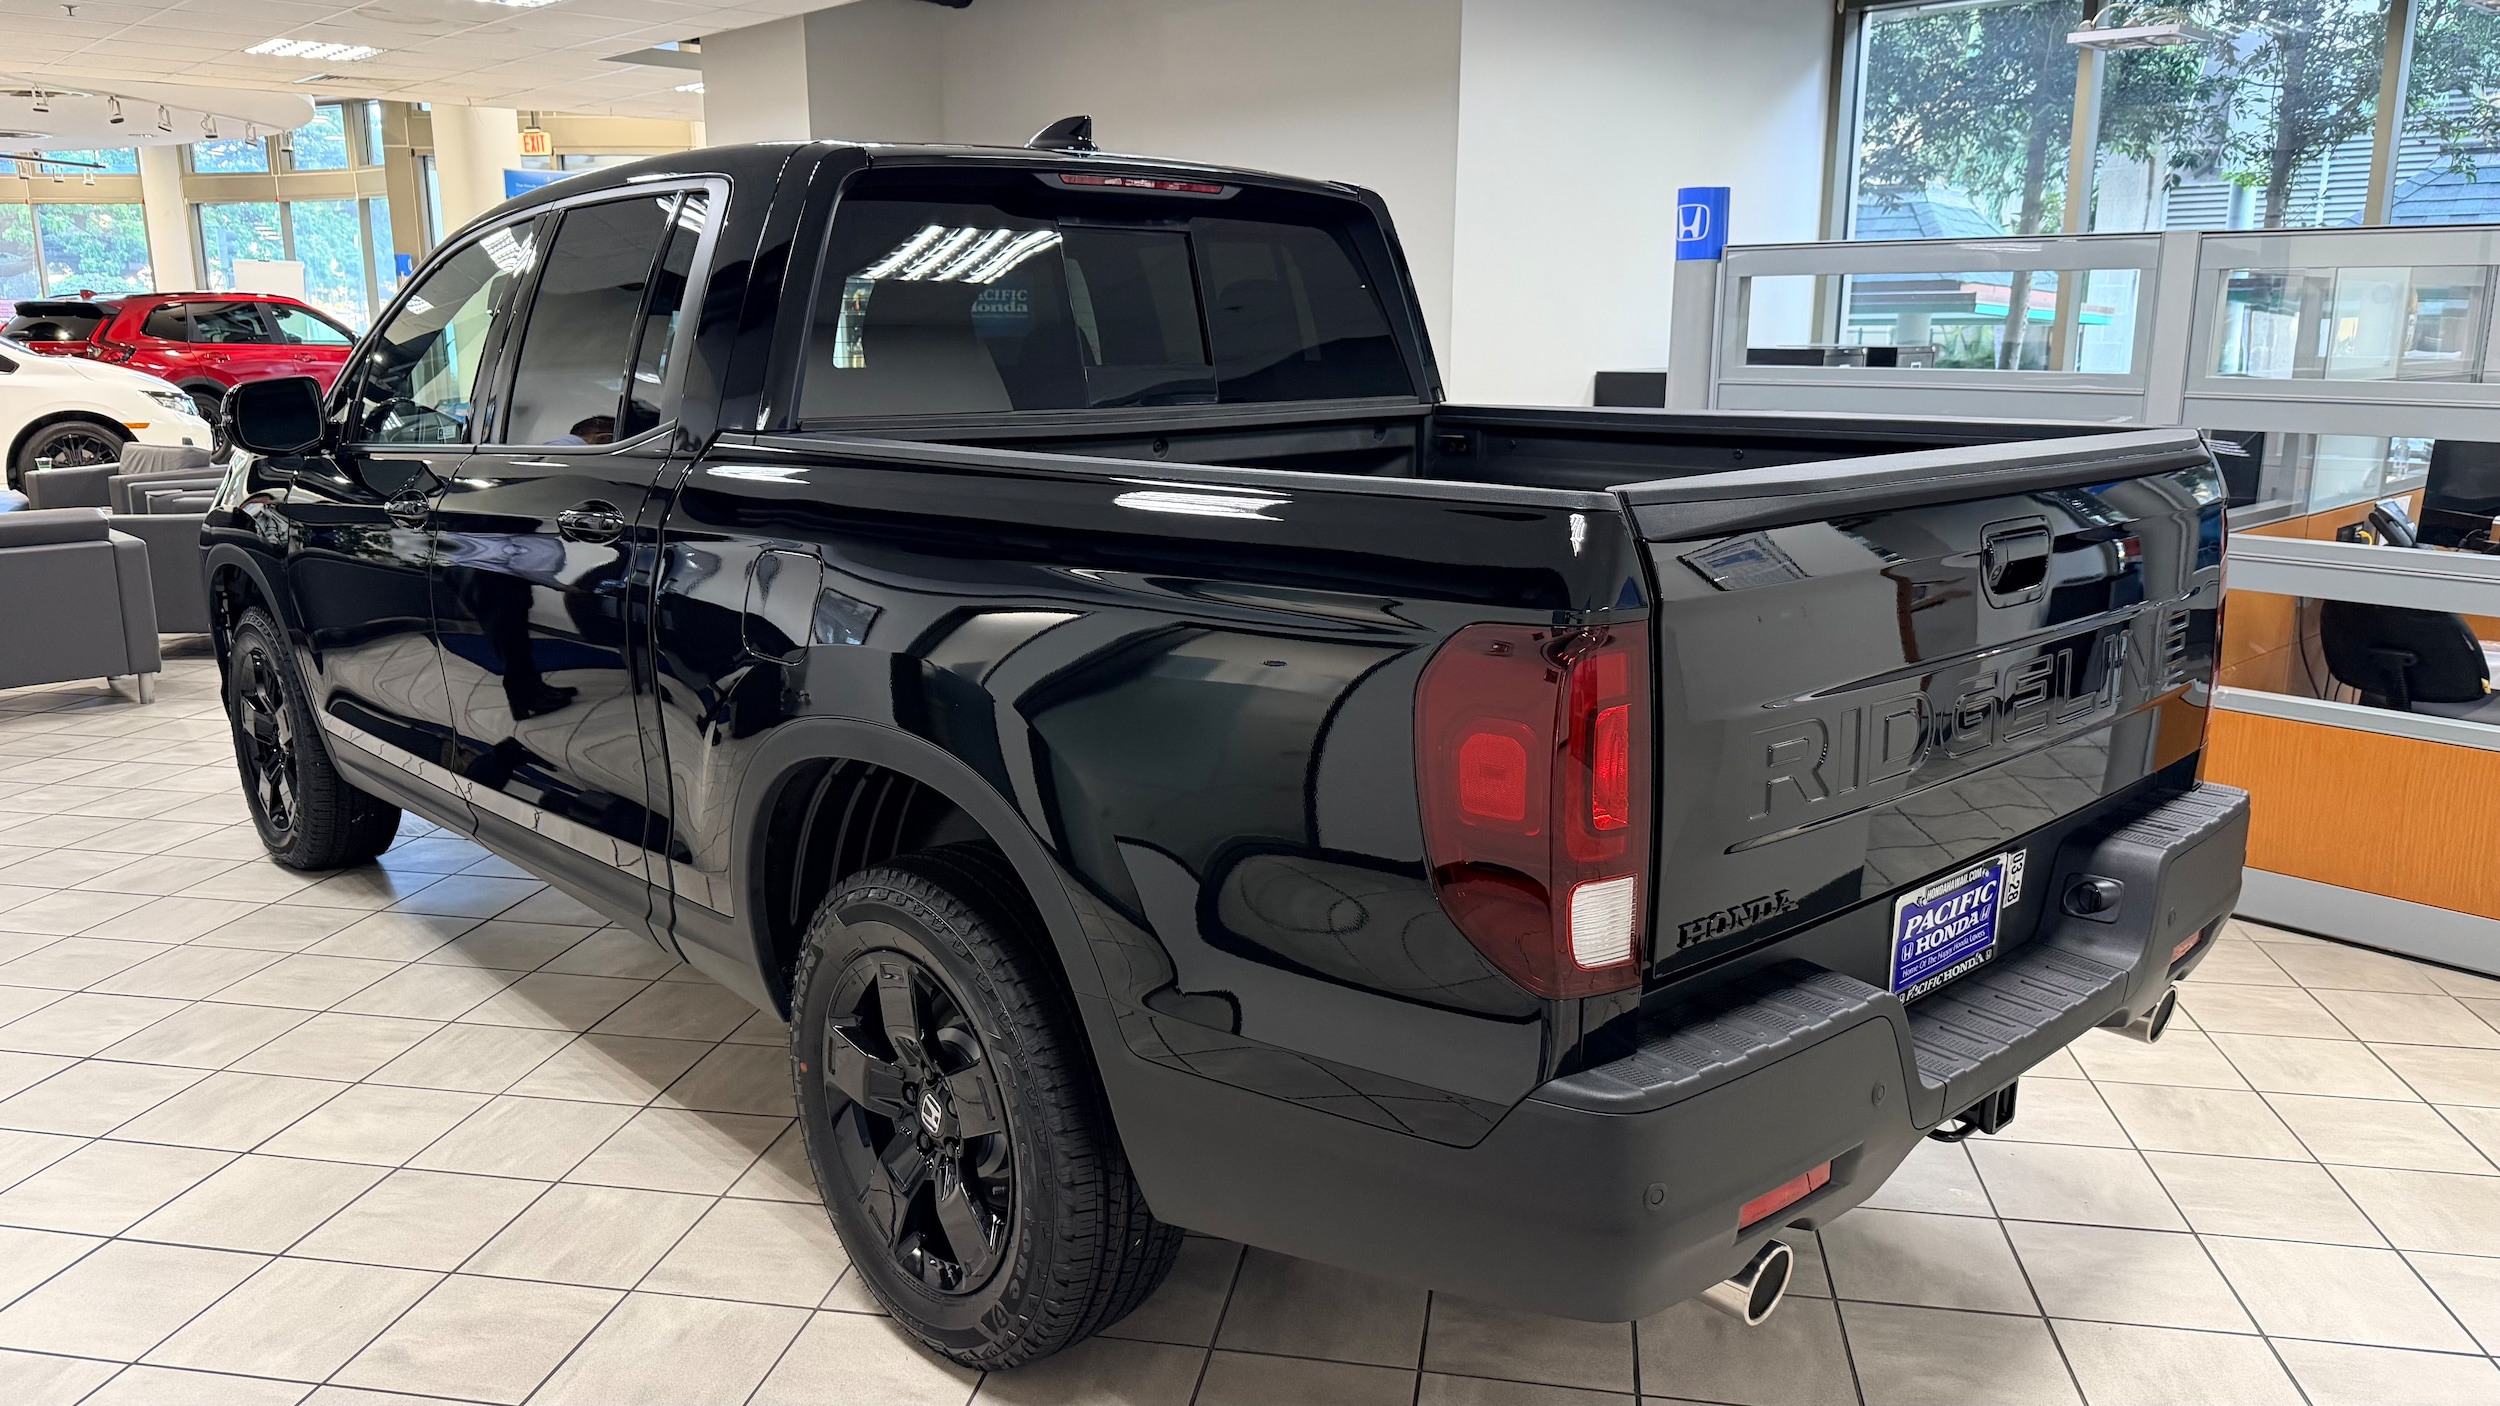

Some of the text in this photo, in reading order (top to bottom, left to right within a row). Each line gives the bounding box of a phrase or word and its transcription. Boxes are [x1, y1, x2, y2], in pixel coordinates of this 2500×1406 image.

[523, 134, 545, 153] EXIT
[1748, 608, 2190, 821] RIDGELINE
[1926, 867, 1983, 898] HONDAHAWAII.COM
[1677, 889, 1799, 949] HONDA
[1902, 880, 1997, 941] PACIFIC
[1914, 910, 1980, 956] HONDA
[1902, 965, 1919, 978] Home
[1920, 959, 1928, 969] Of
[1927, 955, 1937, 965] The
[1953, 938, 1969, 951] Honda
[1969, 930, 1986, 943] Lovers
